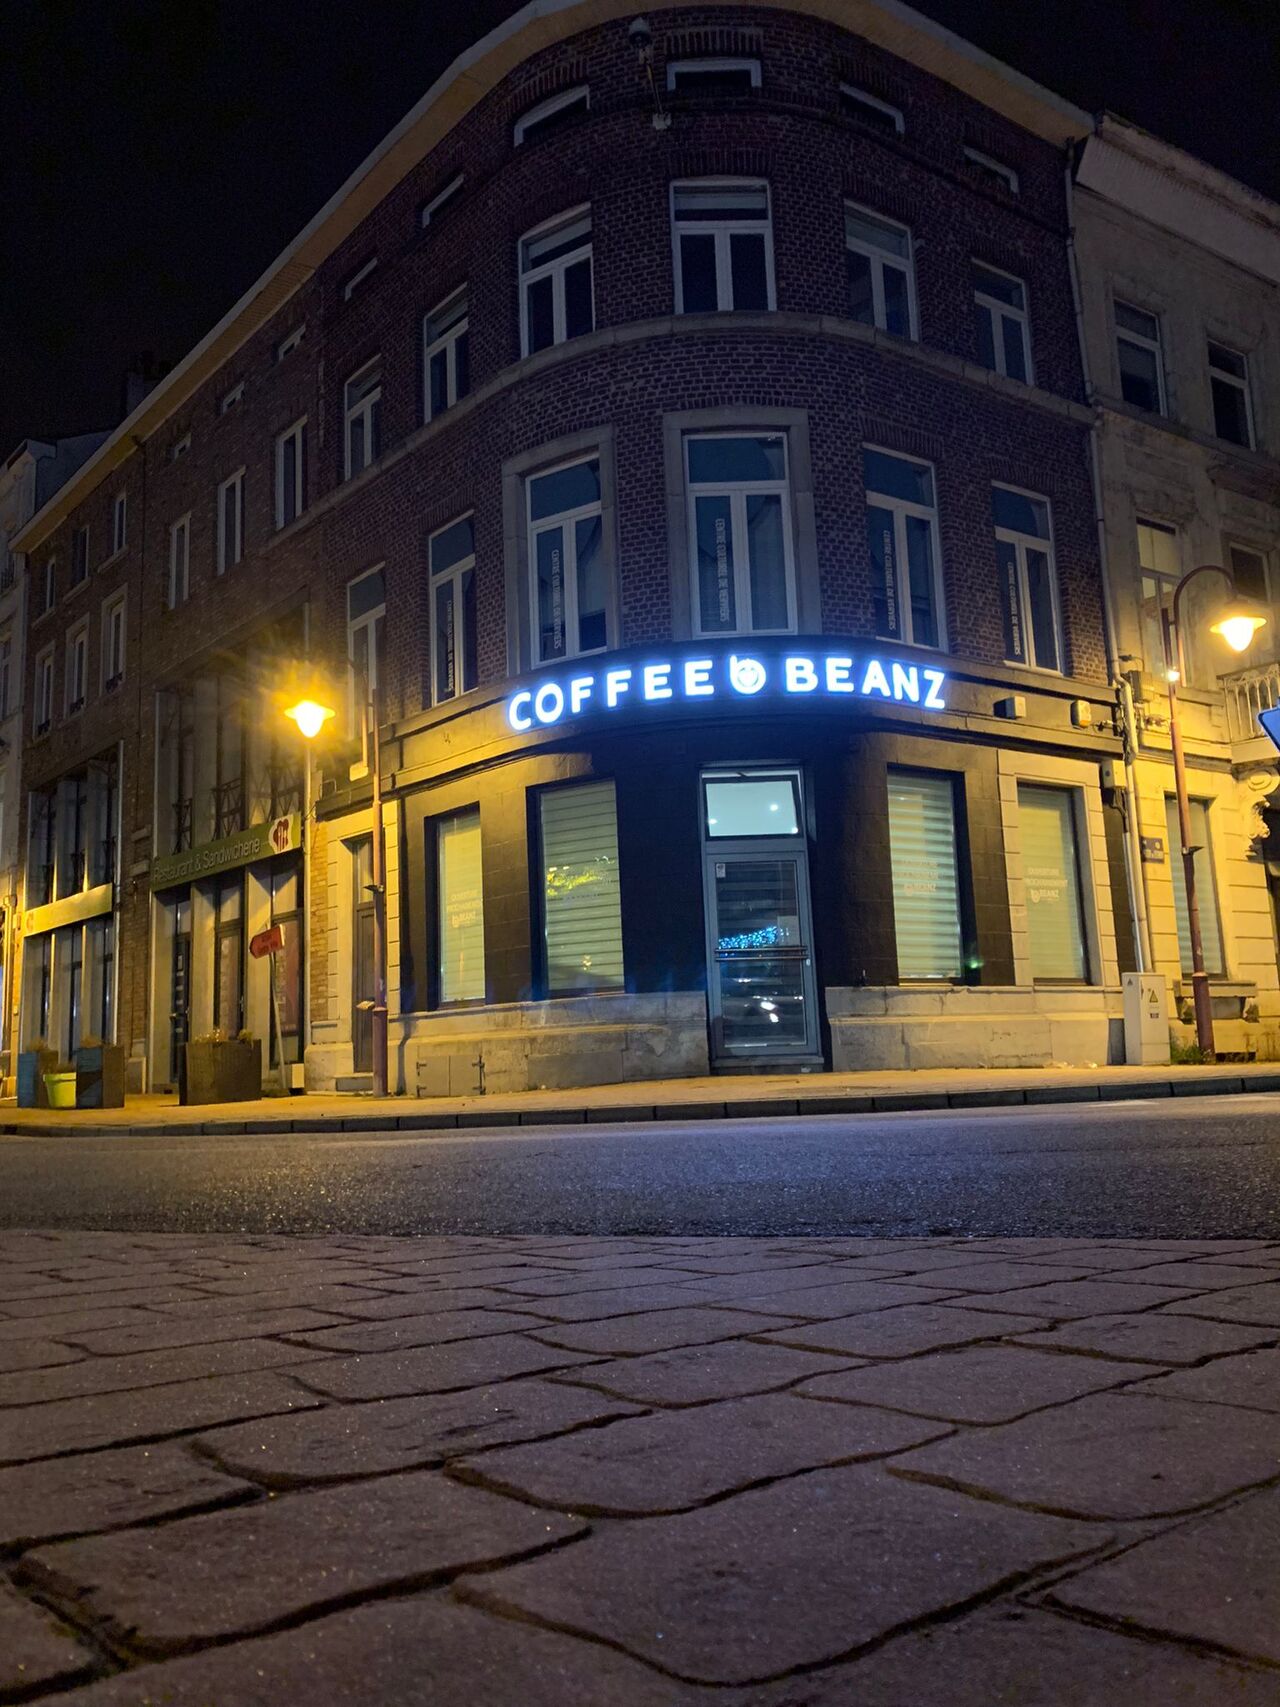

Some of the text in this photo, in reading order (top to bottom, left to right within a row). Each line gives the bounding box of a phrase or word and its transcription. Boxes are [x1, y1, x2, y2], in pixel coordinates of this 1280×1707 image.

[551, 549, 560, 575] CENTRE
[715, 518, 730, 622] CENTRE CULTUREL DE VERVIERS
[1007, 562, 1016, 586] CENTRE
[883, 530, 897, 630] CENTRE CULTUREL DE VERVIERS
[1011, 615, 1019, 624] DE
[1012, 625, 1021, 655] VERVIERS
[508, 659, 714, 732] COFFEE
[785, 656, 946, 710] BEANZ
[153, 858, 195, 884] Restaurant
[195, 853, 201, 871] &
